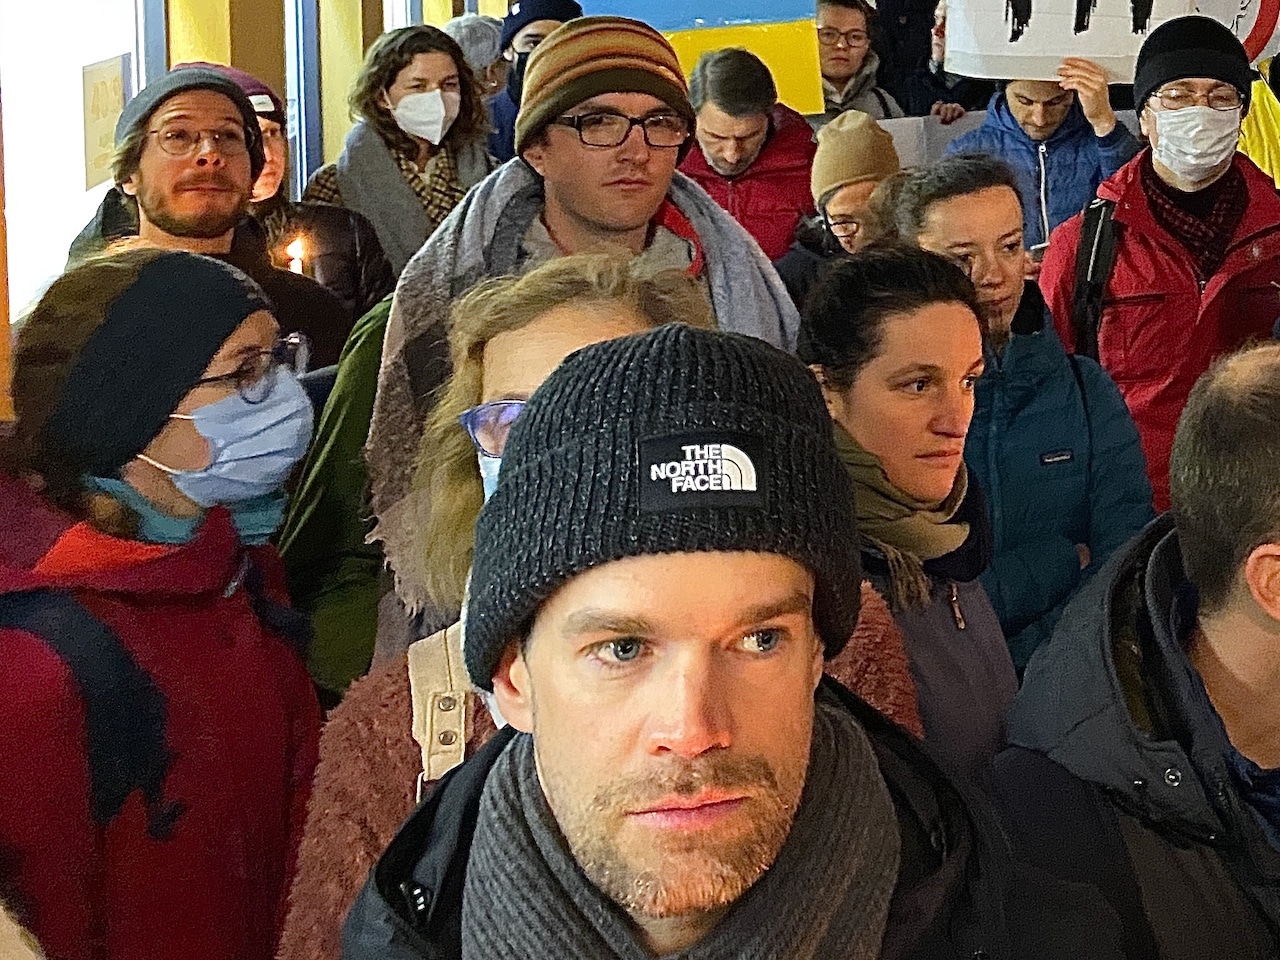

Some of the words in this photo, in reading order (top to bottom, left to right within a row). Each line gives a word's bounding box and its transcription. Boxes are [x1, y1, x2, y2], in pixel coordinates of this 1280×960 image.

[681, 443, 721, 460] THE
[650, 459, 722, 481] NORTH
[671, 474, 722, 493] FACE
